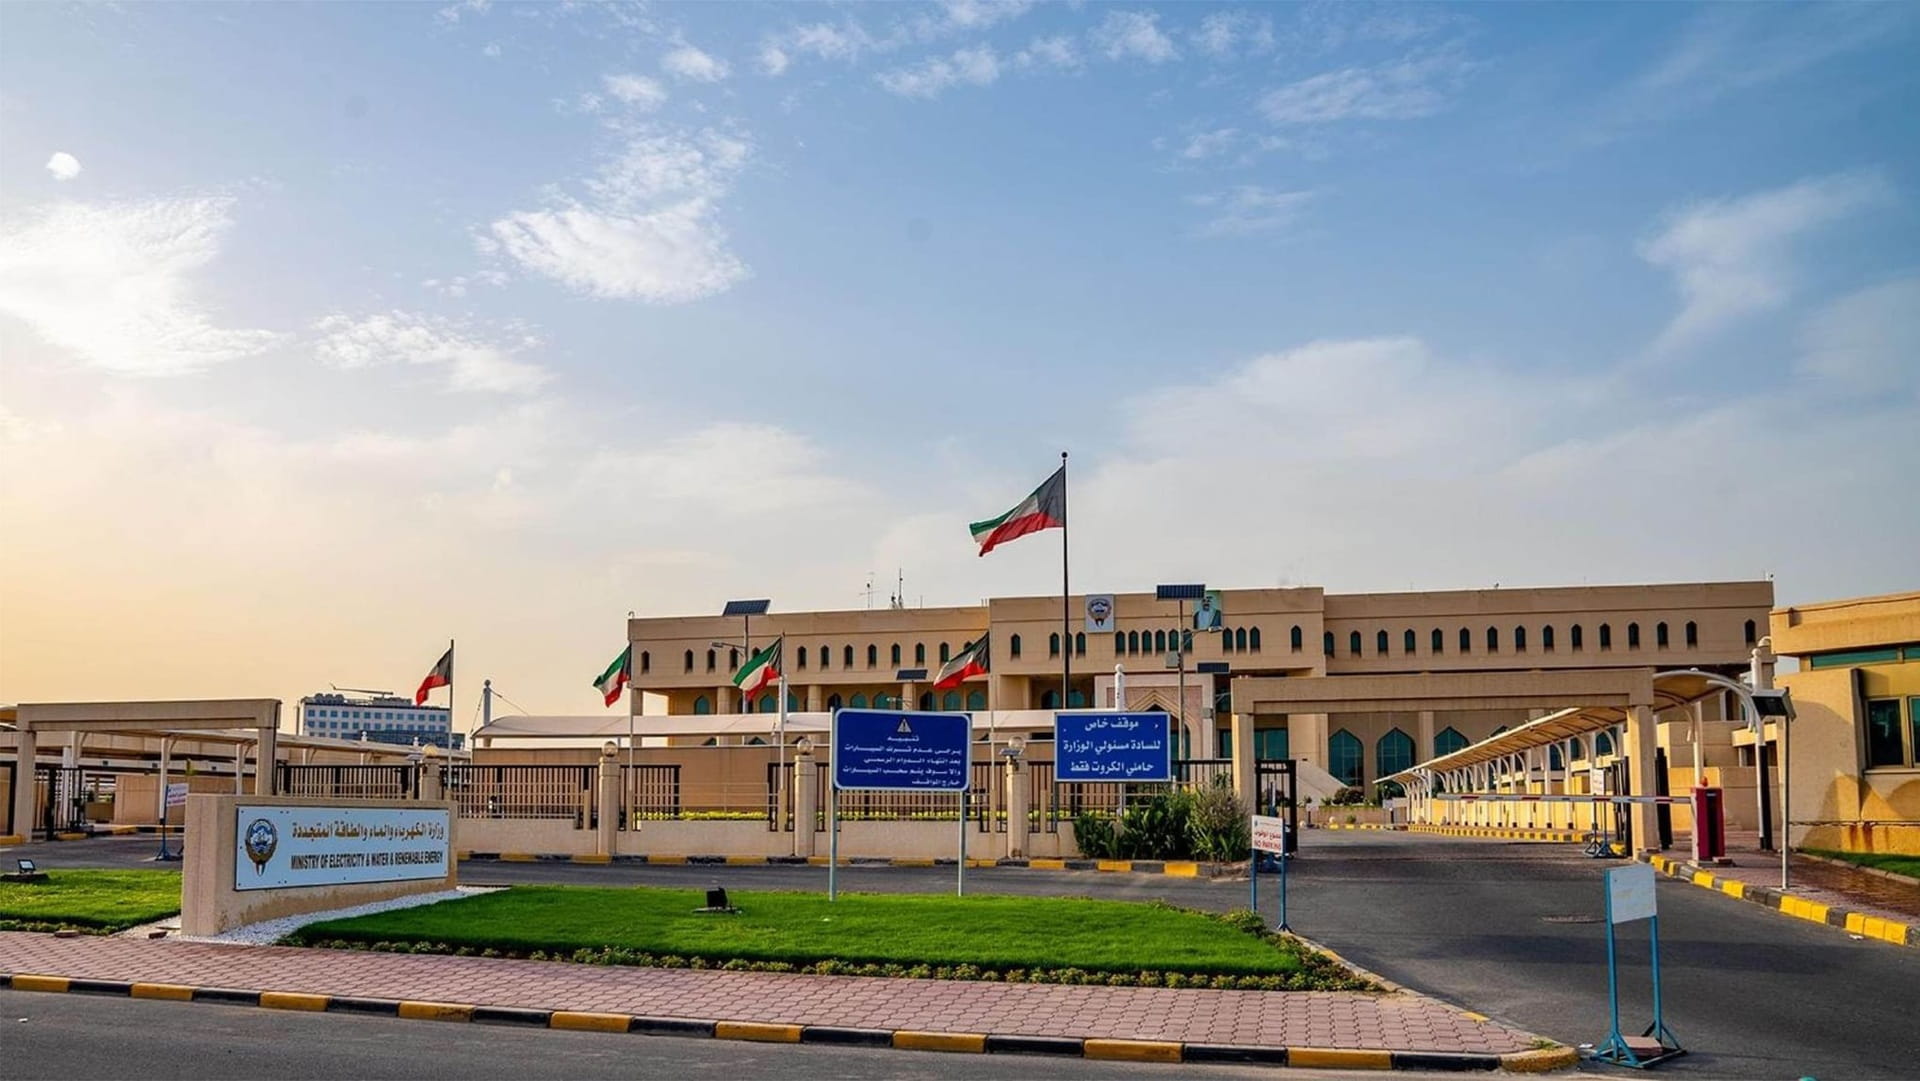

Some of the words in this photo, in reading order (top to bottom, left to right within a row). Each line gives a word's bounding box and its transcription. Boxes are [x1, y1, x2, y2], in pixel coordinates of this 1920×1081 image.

[1085, 718, 1108, 732] خاص
[1110, 717, 1139, 731] موقف
[1063, 739, 1093, 753] الوزارة
[1131, 739, 1161, 750] للسادة
[909, 767, 924, 775] يتم
[925, 768, 948, 776] سوف
[1070, 760, 1090, 772] فقط
[1091, 761, 1124, 775] الكروت
[1126, 761, 1154, 776] حاملي
[292, 822, 333, 842] المتجددة
[334, 821, 368, 841] والطاقة
[369, 824, 394, 841] والماء
[395, 822, 427, 841] الكهرباء
[428, 822, 444, 840] وزارة
[291, 854, 320, 870] MINISTRY
[320, 854, 328, 869] OF
[329, 853, 365, 868] ELECTRICITY
[371, 852, 389, 867] WATER
[395, 851, 424, 865] RENEWABLE
[424, 850, 443, 864] ENERGY
